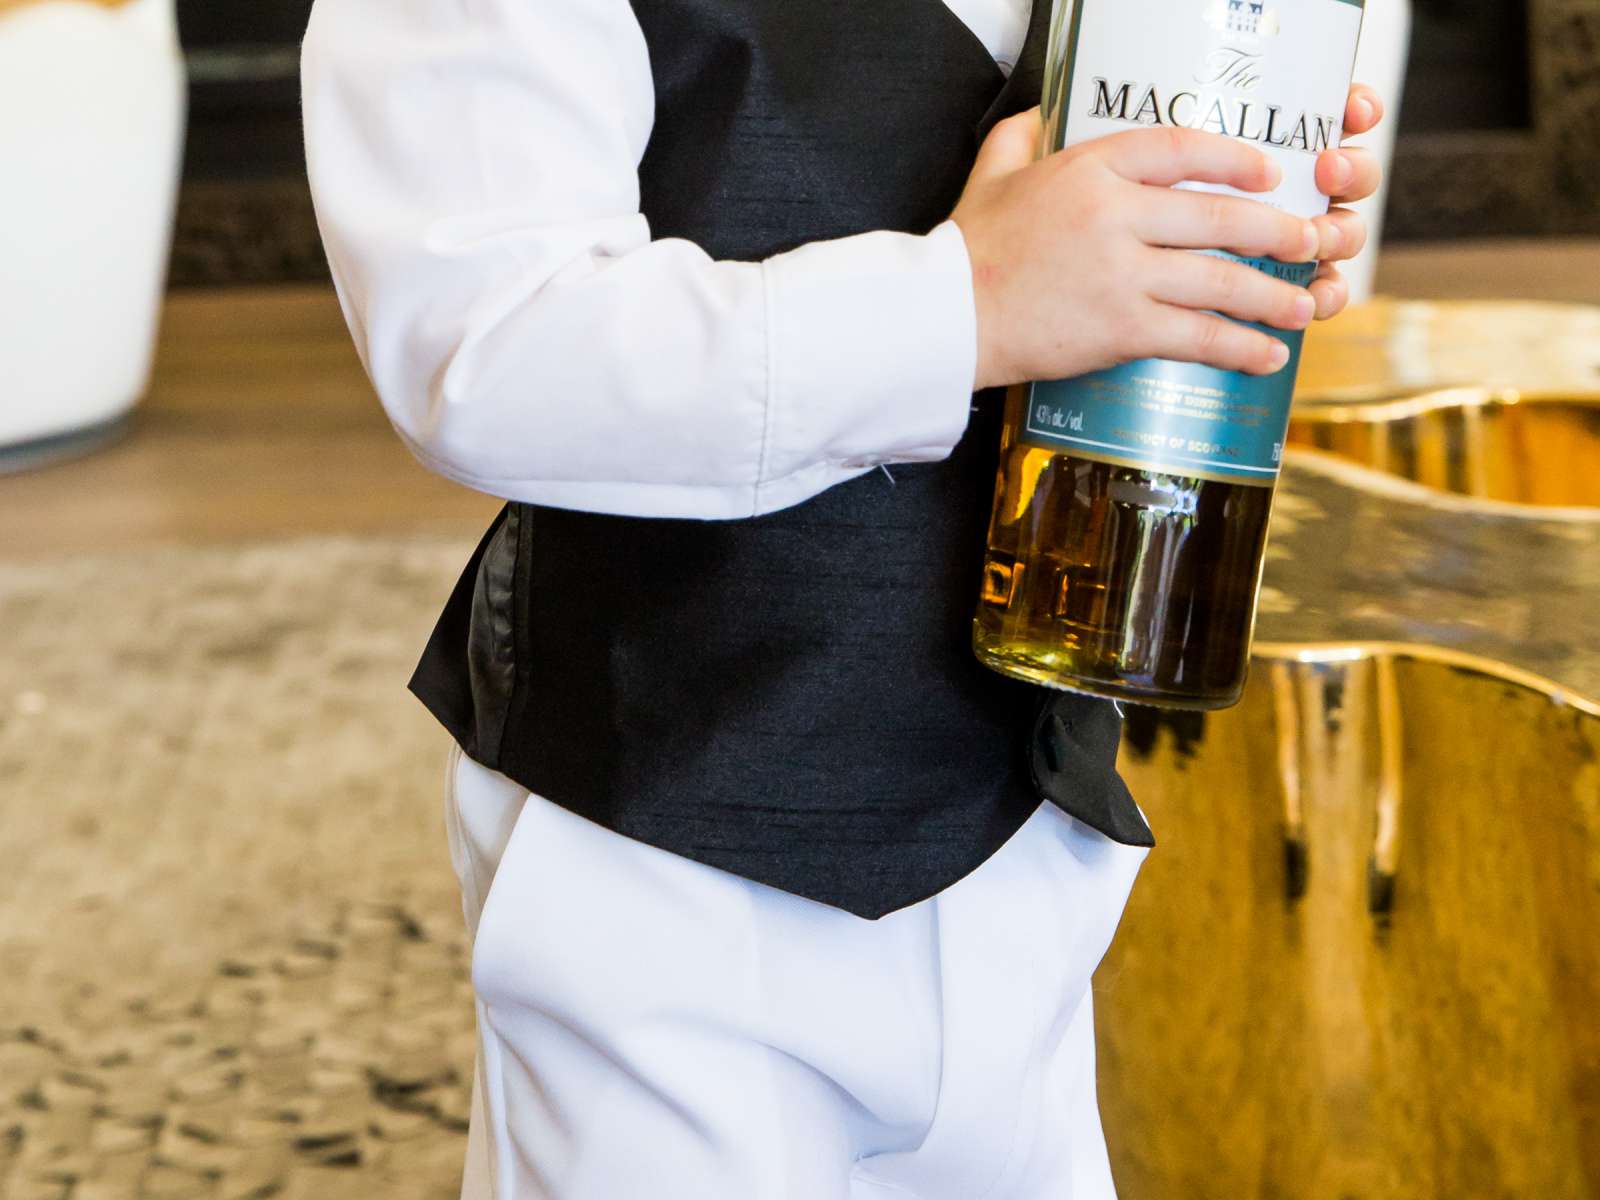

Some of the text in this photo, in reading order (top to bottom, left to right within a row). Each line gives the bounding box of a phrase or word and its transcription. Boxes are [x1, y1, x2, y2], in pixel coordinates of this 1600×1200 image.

[1193, 46, 1264, 89] The
[1088, 76, 1336, 154] MACALLAN
[1168, 435, 1186, 449] OF
